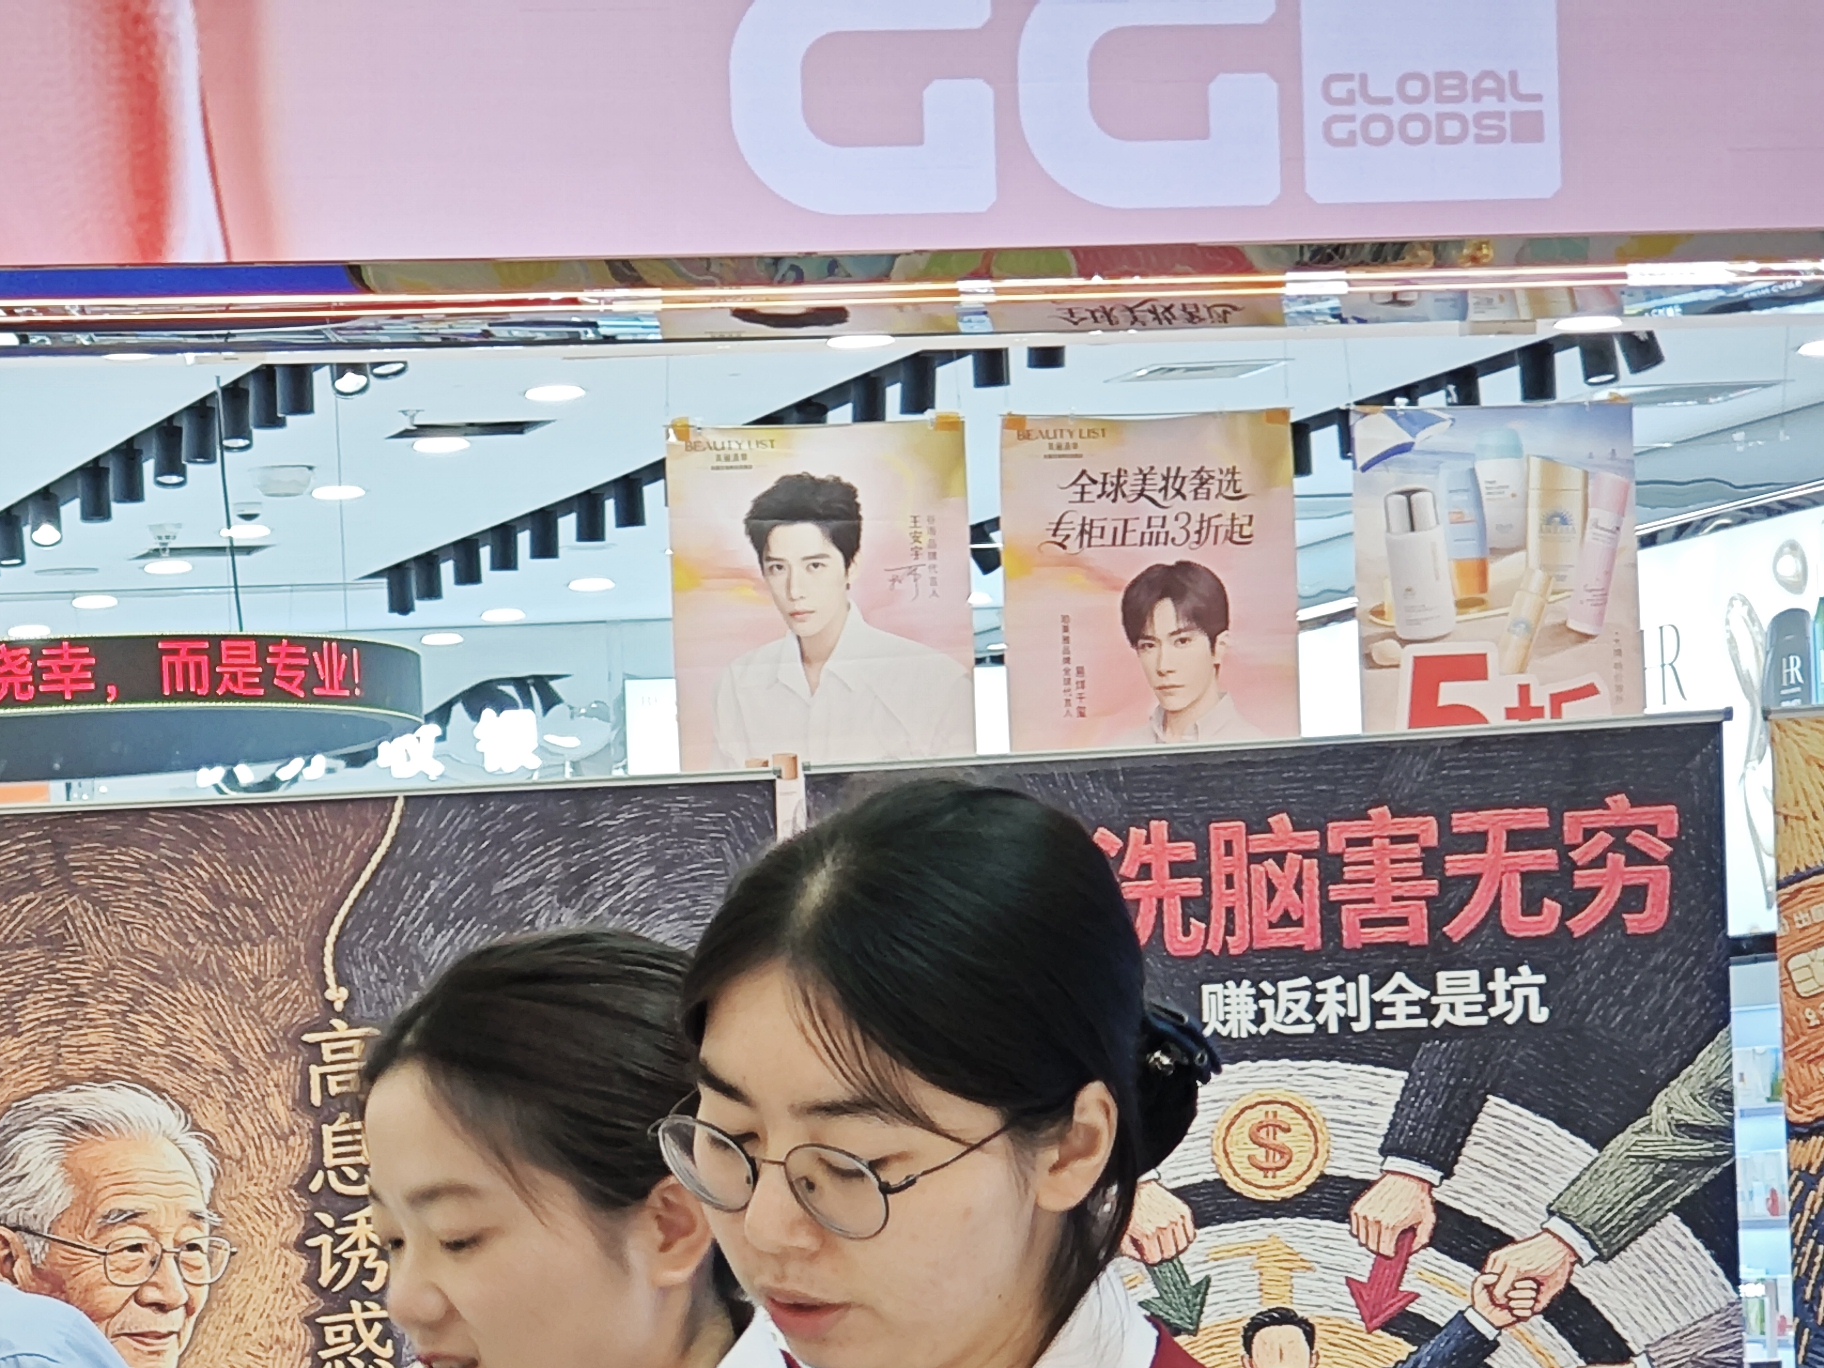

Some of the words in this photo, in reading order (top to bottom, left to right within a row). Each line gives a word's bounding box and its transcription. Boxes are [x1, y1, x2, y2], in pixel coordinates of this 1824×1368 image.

[1321, 69, 1544, 106] GLOBAL
[1322, 110, 1507, 147] GOODS
[685, 440, 744, 451] BEAUTY
[748, 439, 776, 450] LIST
[1017, 429, 1075, 440] BEAUTY
[1079, 428, 1107, 439] LIST
[1057, 466, 1255, 509] 全球美妆奢选
[1037, 510, 1255, 554] 专柜正品3折起
[1093, 794, 1679, 957] 洗脑害无穷
[1201, 965, 1549, 1038] 赚返利全是坑
